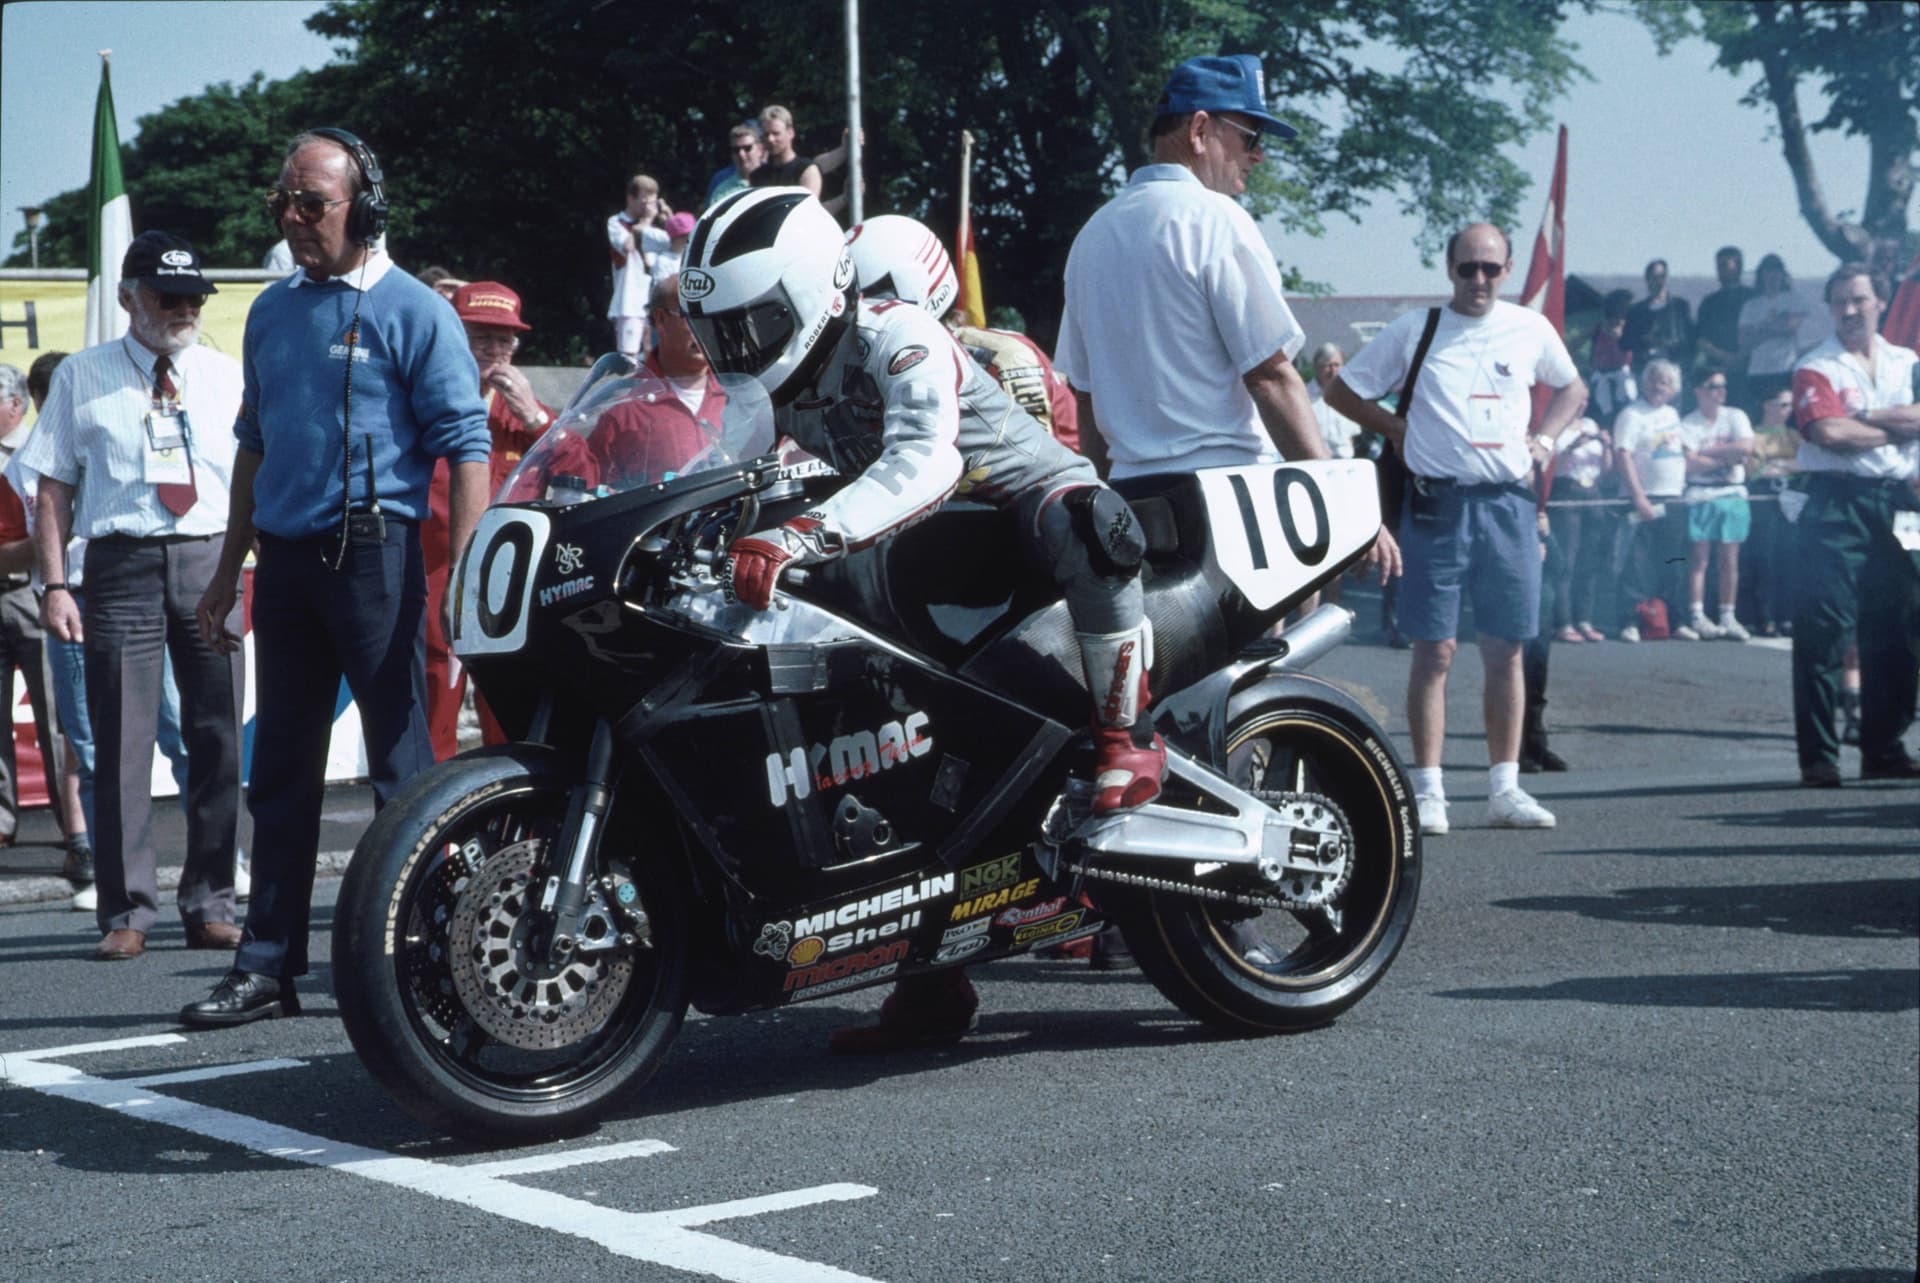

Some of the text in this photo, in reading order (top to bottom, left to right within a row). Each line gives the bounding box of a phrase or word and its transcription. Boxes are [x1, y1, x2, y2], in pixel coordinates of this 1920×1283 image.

[681, 272, 710, 293] Arai
[804, 309, 831, 351] ROBERT
[1226, 467, 1331, 571] 10
[453, 520, 534, 640] 10
[539, 575, 595, 607] HYMAC
[1364, 737, 1406, 801] MICHELIN
[384, 824, 439, 956] MICHELIN
[964, 856, 1019, 891] NGK
[794, 873, 955, 938] MICHELIN
[950, 878, 1040, 922] MIRAGE
[827, 910, 921, 953] Shell
